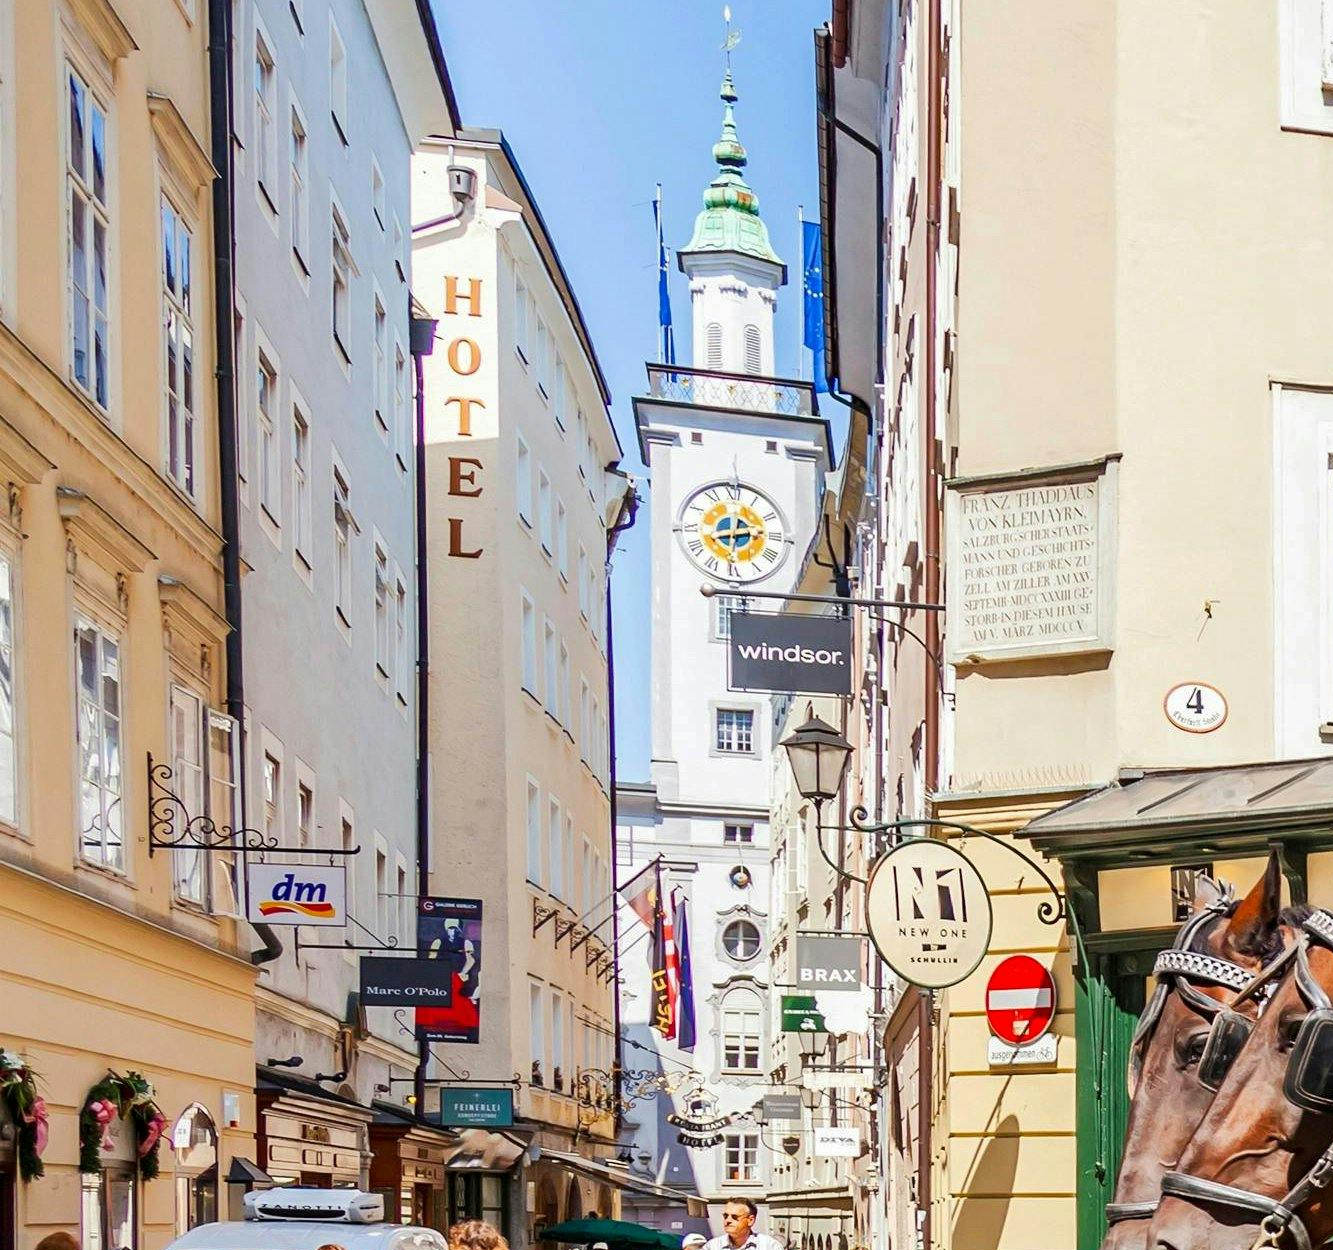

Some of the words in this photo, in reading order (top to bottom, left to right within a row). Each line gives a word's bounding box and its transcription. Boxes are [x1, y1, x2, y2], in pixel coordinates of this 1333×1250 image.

[443, 275, 485, 559] HOTEL
[961, 494, 1010, 515] FRANZ
[969, 517, 998, 531] VON
[962, 552, 995, 564] MANN
[997, 548, 1020, 560] UND
[964, 563, 1018, 581] FORSCHER
[1021, 557, 1072, 573] GEBOREN
[1075, 554, 1089, 568] ZU
[964, 582, 992, 596] ZELL
[1013, 576, 1051, 591] ZILLER
[1013, 606, 1054, 622] DIESEM
[1057, 602, 1093, 617] HAUSE
[1003, 622, 1034, 639] MÄRZ
[738, 642, 845, 666] windsor.
[1186, 687, 1204, 714] 4
[272, 873, 326, 902] dm
[899, 928, 930, 938] NEW
[940, 928, 967, 938] ONE
[800, 968, 857, 983] BRAX
[367, 986, 401, 996] Marc
[404, 986, 447, 997] O'Polo
[454, 1103, 501, 1111] FEINERLEI
